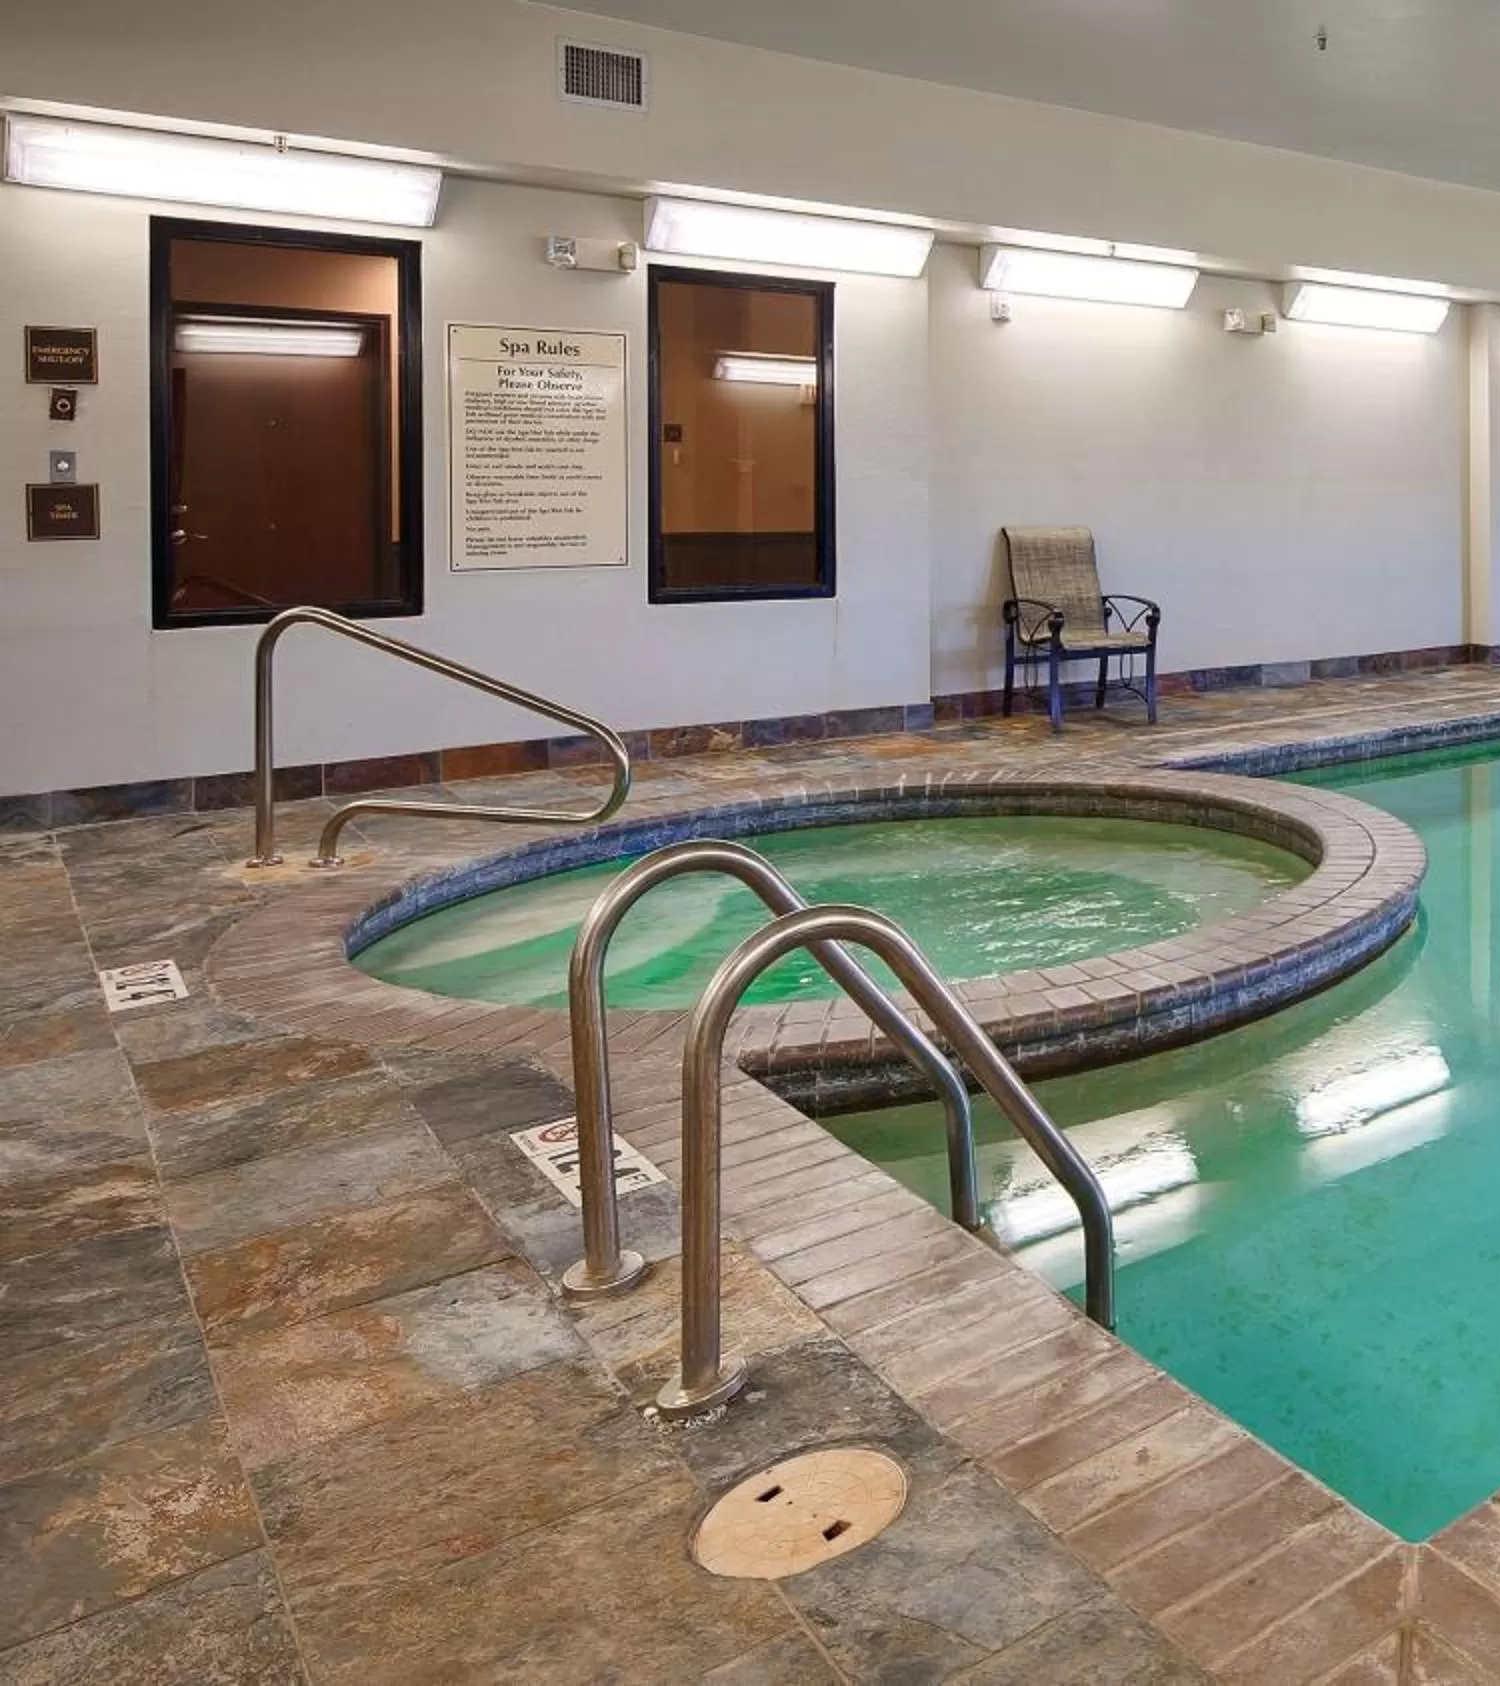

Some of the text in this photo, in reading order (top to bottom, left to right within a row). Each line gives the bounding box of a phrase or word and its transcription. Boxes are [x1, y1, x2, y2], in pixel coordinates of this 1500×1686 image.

[32, 345, 90, 355] EMERGENCY
[499, 337, 581, 358] Spa Rules
[497, 365, 583, 381] For Your Safety,
[499, 378, 583, 391] Please Observe
